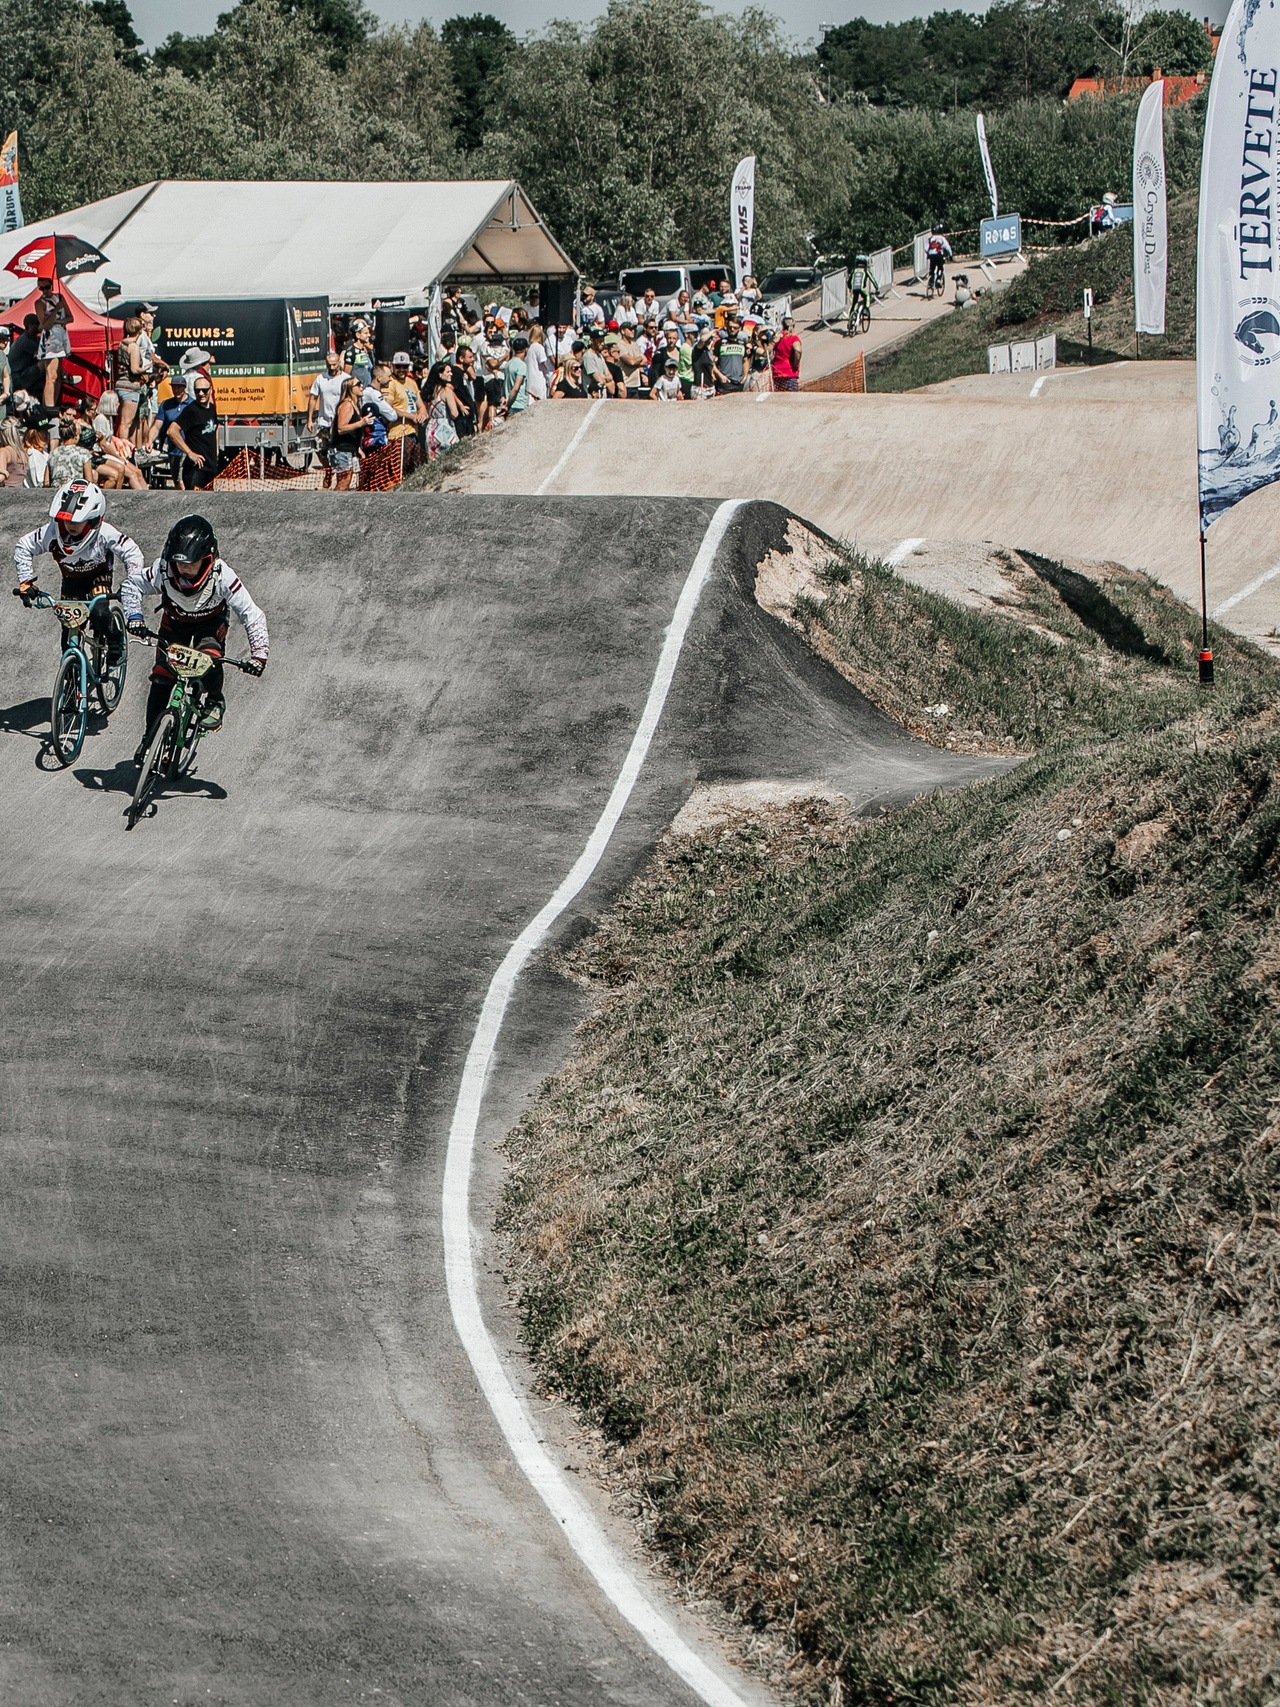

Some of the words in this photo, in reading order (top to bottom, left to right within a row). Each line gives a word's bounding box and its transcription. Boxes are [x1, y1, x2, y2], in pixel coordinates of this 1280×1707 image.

[1234, 68, 1277, 281] TĒRVETE
[1144, 191, 1158, 238] Crystal
[738, 205, 750, 269] TELMS
[165, 327, 235, 338] TUKUMS-2
[238, 386, 265, 394] Tukumā
[176, 652, 199, 670] 211
